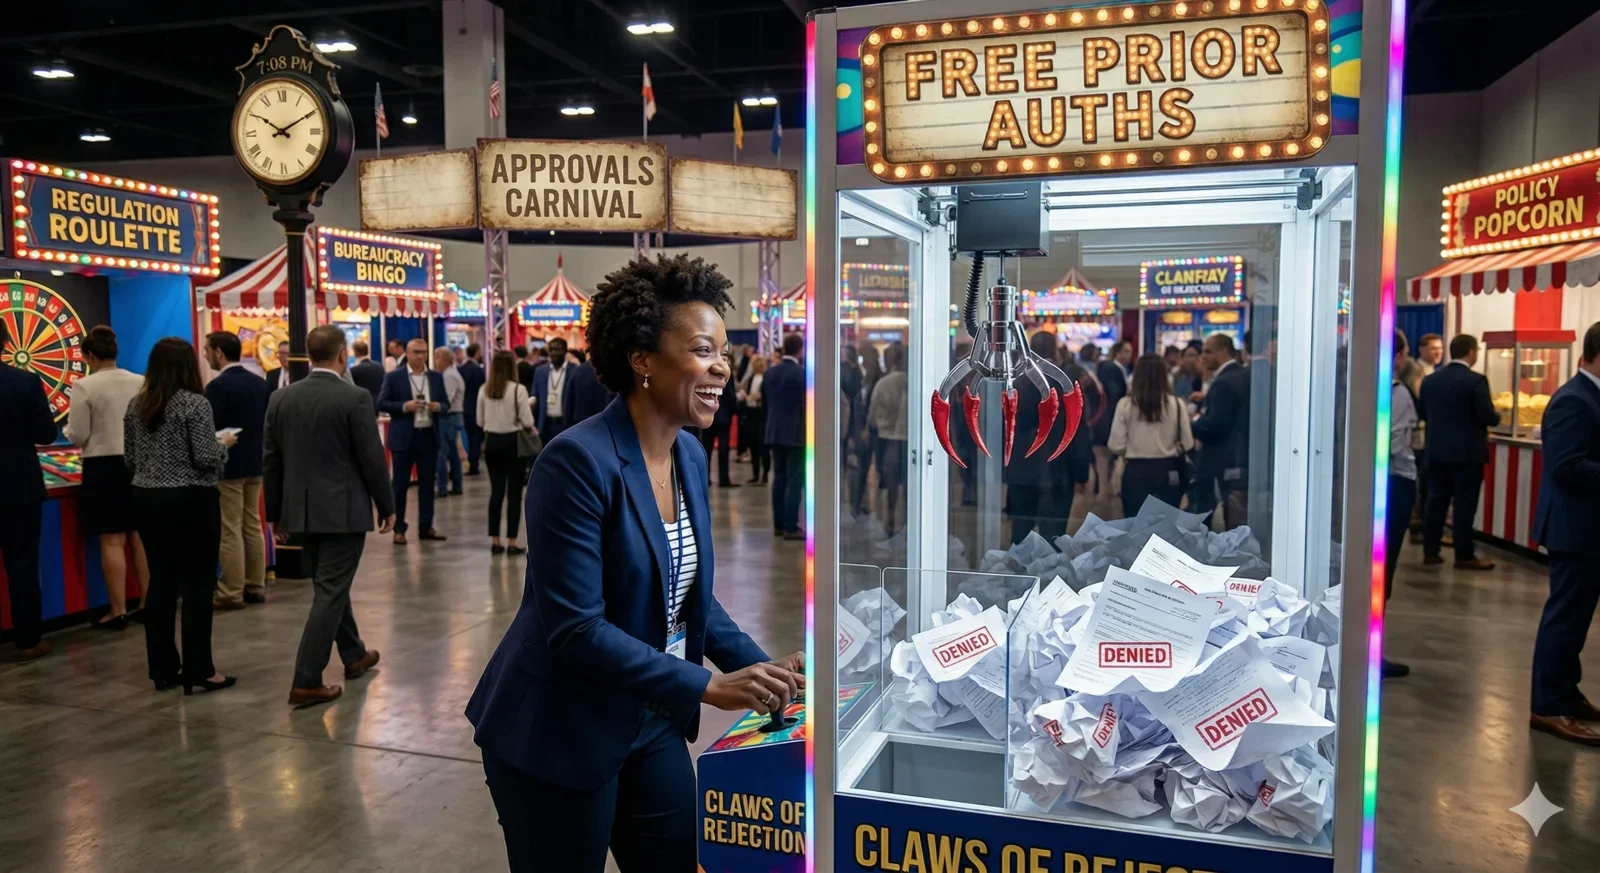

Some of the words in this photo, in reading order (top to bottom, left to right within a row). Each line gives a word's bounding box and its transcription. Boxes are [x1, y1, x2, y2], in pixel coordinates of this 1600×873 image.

[257, 56, 287, 75] 7:08
[291, 55, 313, 74] PM
[904, 40, 1058, 101] FREE
[1082, 24, 1284, 88] PRIOR
[982, 87, 1196, 150] AUTHS
[491, 153, 654, 186] APPROVALS
[51, 188, 179, 227] REGULATION
[505, 188, 642, 219] CARNIVAL
[1495, 174, 1560, 209] POLICY
[49, 213, 182, 254] ROULETTE
[1474, 195, 1584, 240] POPCORN
[334, 241, 425, 268] BUREAUCRACY
[356, 261, 407, 285] BINGO
[939, 632, 990, 664] DENIED
[1104, 647, 1166, 663] DENIED
[1204, 697, 1268, 744] DENIED
[704, 789, 774, 822] CLAWS
[780, 800, 805, 826] OF
[703, 817, 806, 855] REJECTION
[855, 824, 988, 873] CLAWS
